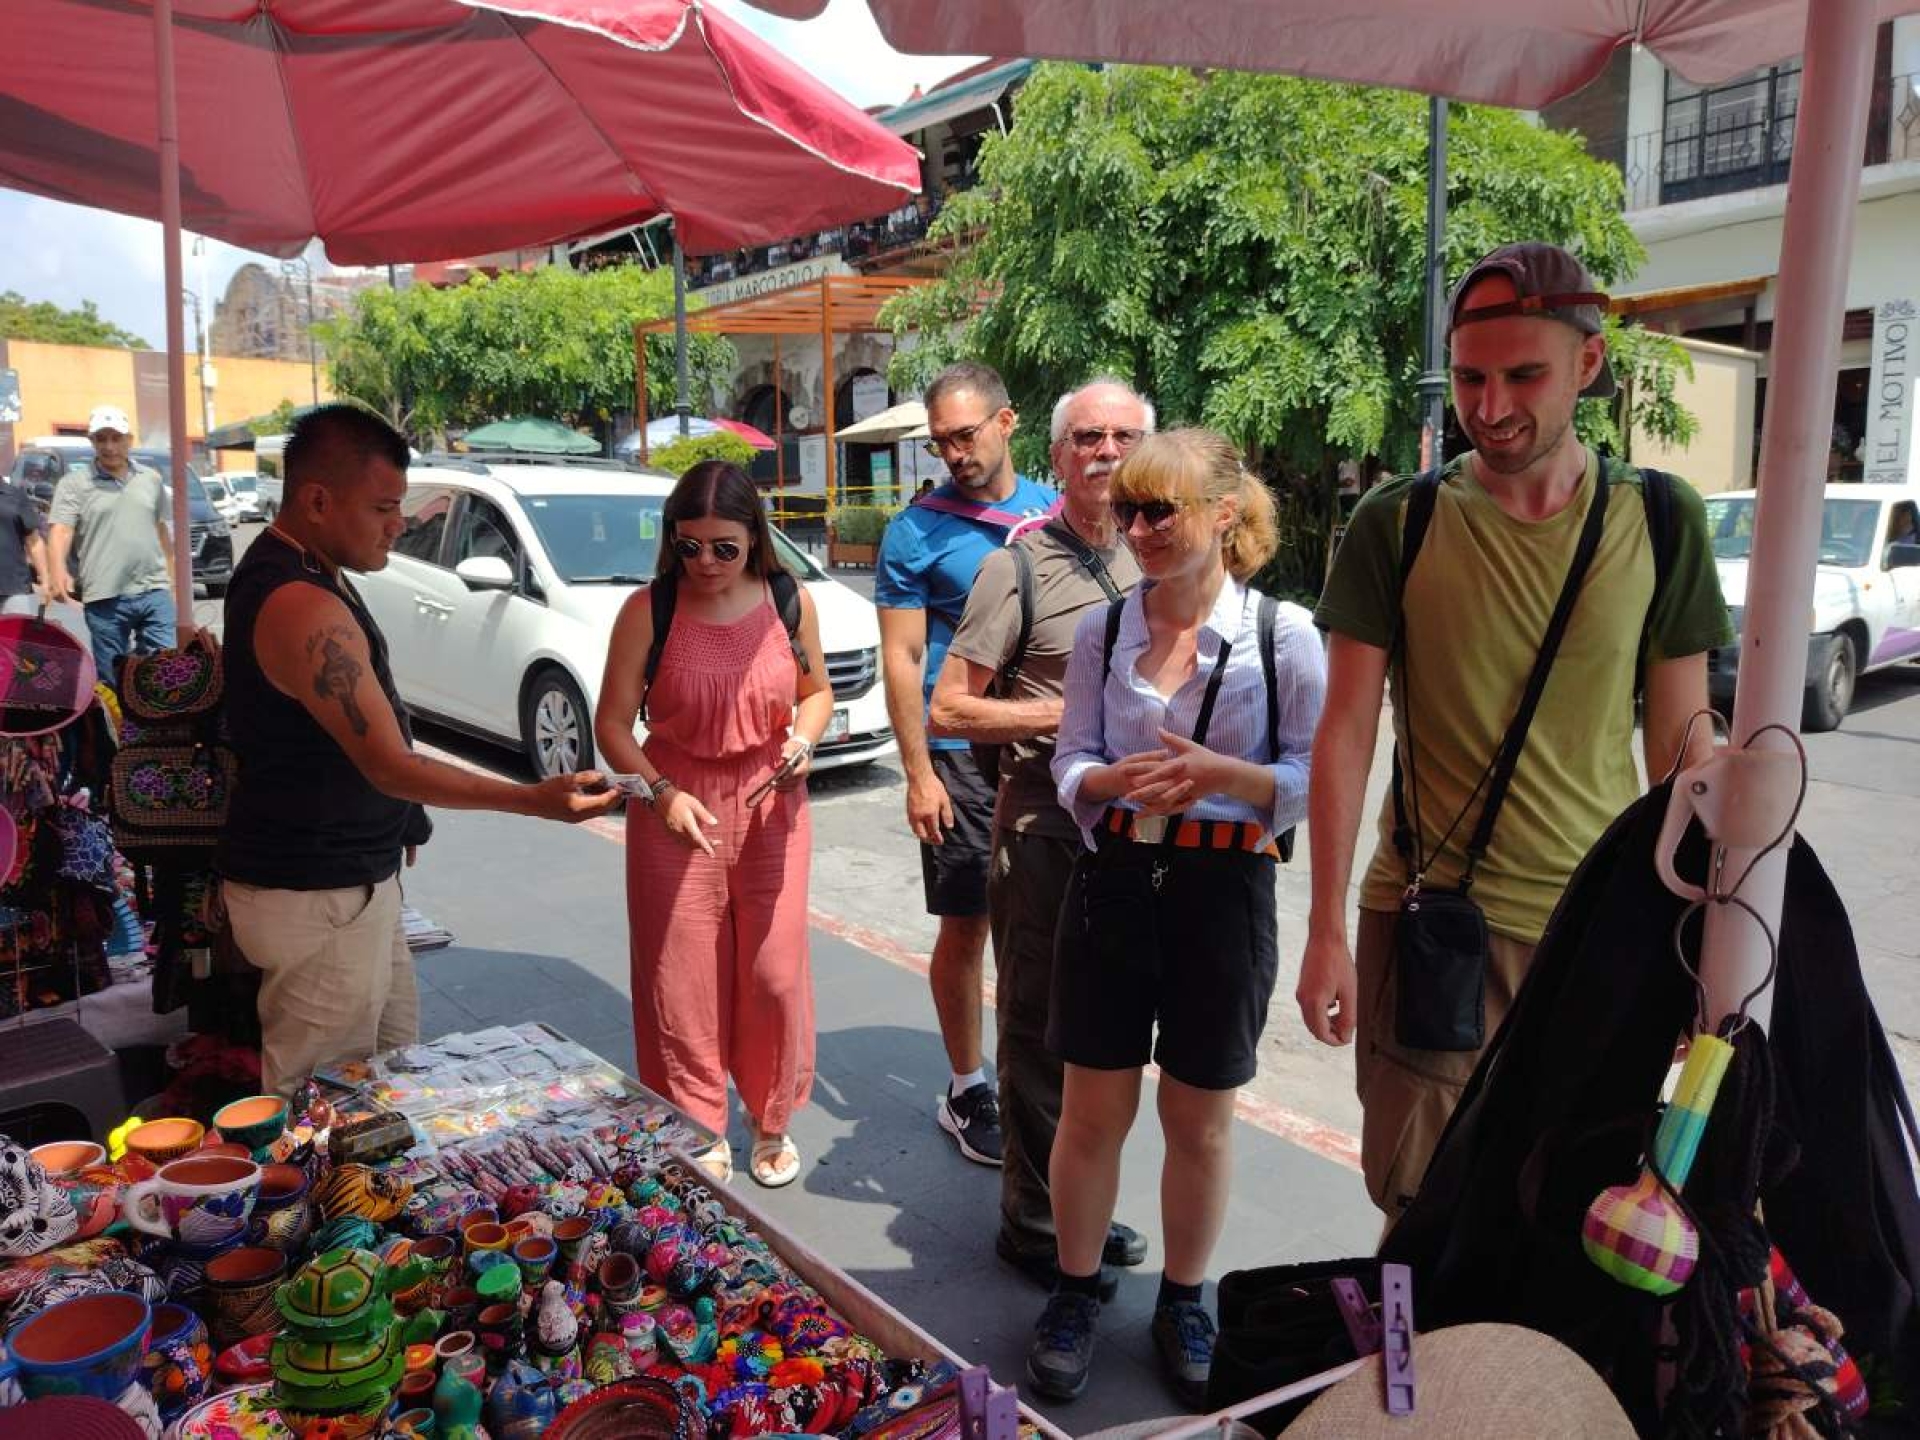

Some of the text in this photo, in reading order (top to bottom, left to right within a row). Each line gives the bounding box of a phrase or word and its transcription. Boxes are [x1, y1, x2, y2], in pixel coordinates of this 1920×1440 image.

[735, 274, 777, 299] MARCO
[779, 265, 812, 288] POLO
[1876, 322, 1908, 464] EL MOTIVO
